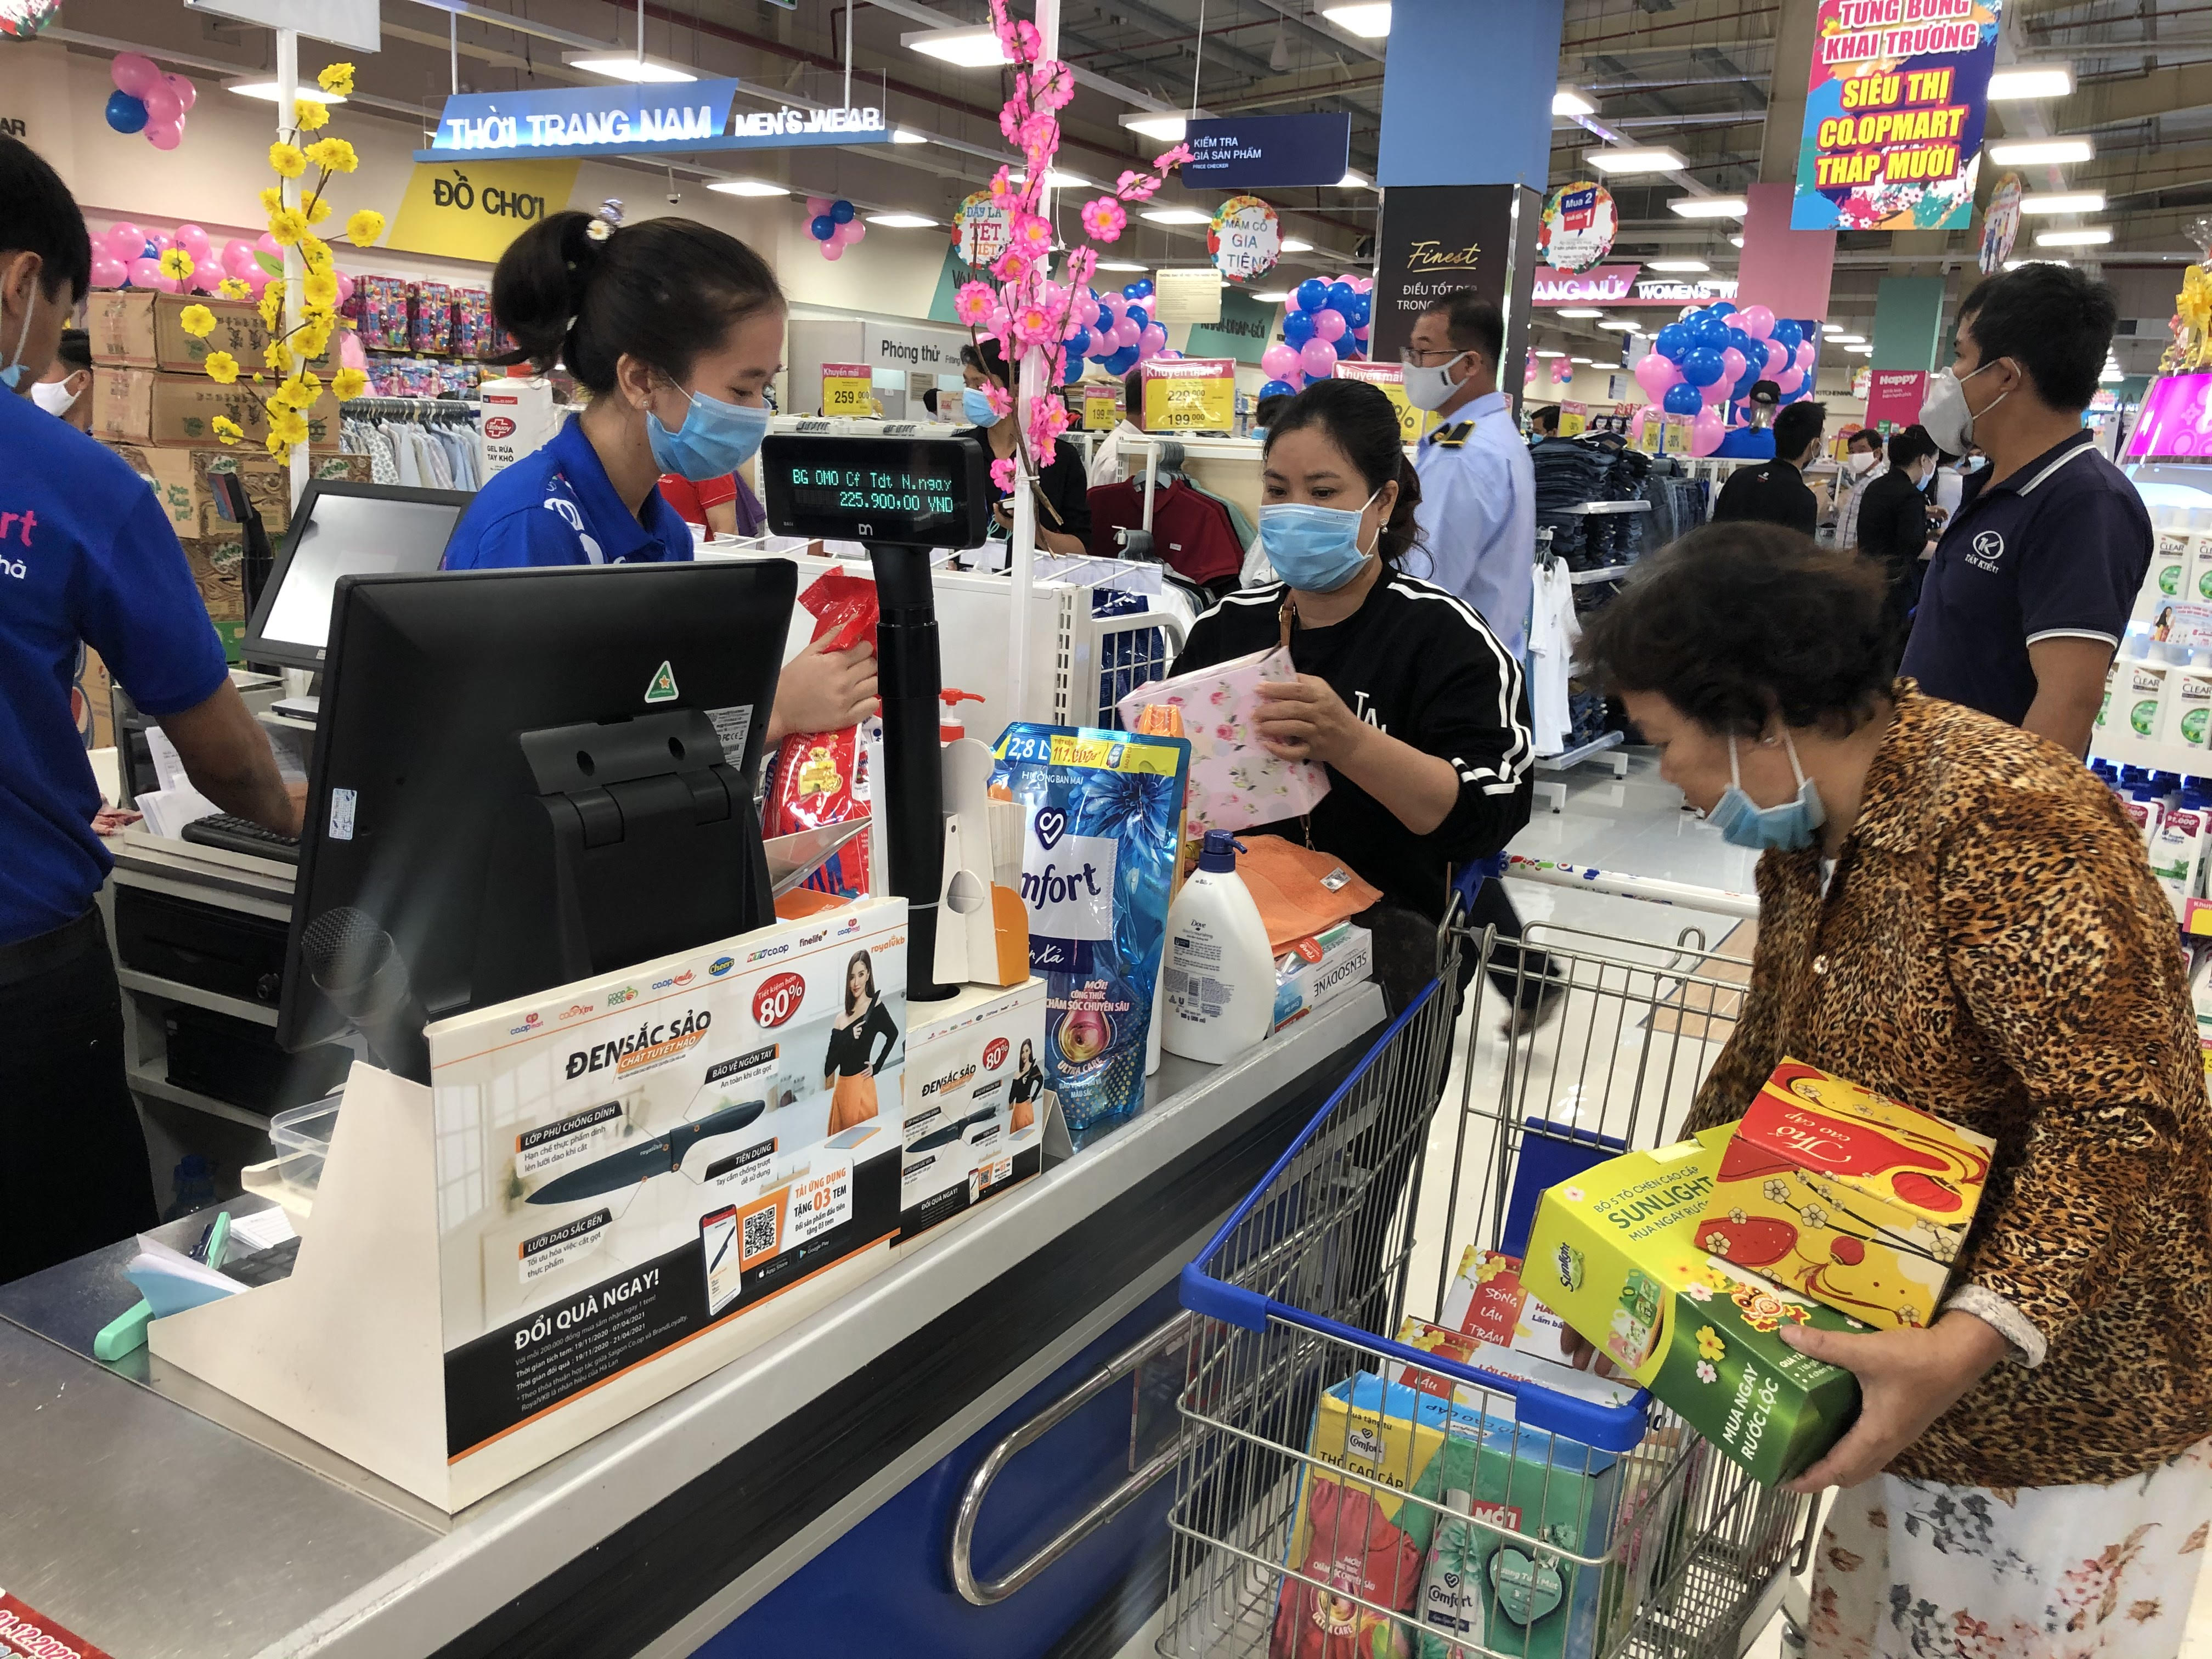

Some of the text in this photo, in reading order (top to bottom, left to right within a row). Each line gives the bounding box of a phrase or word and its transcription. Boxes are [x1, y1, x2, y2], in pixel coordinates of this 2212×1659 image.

[1825, 23, 1977, 61] KHAI TRƯƠNG
[1842, 70, 1950, 109] SIÊU THỊ
[447, 104, 879, 150] THỜI TRANG NAM MEN'S WEAR
[1819, 108, 1965, 149] CO.OPMART
[1193, 146, 1262, 161] GIÁ SẢN PHẨM
[1194, 136, 1238, 148] KIỂM TRA
[1817, 144, 1955, 185] THÁP MƯỜI
[433, 170, 545, 220] ĐỒ CHƠI
[1566, 193, 1592, 208] Mua 2
[1584, 209, 1592, 226] 1
[1232, 233, 1258, 249] GIA
[1407, 241, 1481, 268] Finest
[1403, 281, 1428, 295] ĐIỀU
[1431, 281, 1453, 295] TỐT
[882, 340, 919, 364] Phòng
[922, 344, 940, 363] thử
[823, 366, 859, 377] Khuyến mãi
[1880, 374, 1918, 386] Happy
[487, 424, 511, 432] Lifebuoy
[793, 469, 952, 492] BG OMO Cf Tdt N.ngay
[840, 492, 953, 513] 225.900,00 VND
[2159, 542, 2185, 552] CLEAR
[2133, 675, 2160, 687] CLEAR
[1056, 775, 1084, 785] BAN MAI
[1190, 919, 1206, 928] Dove
[799, 934, 823, 948] finelife
[709, 957, 735, 975] Cheers
[1313, 951, 1367, 997] SENSODYNE
[758, 975, 797, 1001] Tiết kiệm hơn
[1070, 990, 1105, 1000] CÔNG THỨC
[1084, 979, 1108, 990] MỚI!
[759, 982, 803, 1028] 80%
[1068, 1000, 1084, 1011] SÓC
[1084, 1001, 1114, 1012] CHUYÊN
[1115, 1001, 1130, 1012] SÂU
[670, 1009, 712, 1040] SẢO
[713, 1049, 773, 1077] BẢO VỆ NGÓN TAY
[986, 1045, 1008, 1070] 80%
[960, 1064, 976, 1079] SẢO
[525, 1105, 616, 1146] LỚP PHỦ CHỐNG DÍNH
[1784, 1113, 1850, 1141] cao cấp
[736, 1143, 771, 1165] TIỆN DỤNG
[795, 1167, 846, 1199] TẢI ỨNG DỤNG
[1593, 1200, 1611, 1213] BỘ
[1616, 1189, 1634, 1200] TÔ
[1633, 1180, 1662, 1194] CHÉN
[1660, 1172, 1682, 1184] CAO
[1680, 1166, 1699, 1177] CẤP
[794, 1184, 847, 1218] TẶNG 03 TEM
[1608, 1176, 1714, 1229] SUNLIGHT
[528, 1214, 603, 1252] LƯỠI DAO SẮC BÉN
[1628, 1210, 1686, 1242] MUA NGAY
[1559, 1242, 1574, 1293] Sunlight
[515, 1268, 659, 1351] ĐỔI QUÀ NGAY!
[516, 1311, 645, 1379] Thời gian tích tem: 19/11/2020 07/04/2021
[1723, 1362, 1758, 1444] MUA NGAY
[1741, 1378, 1779, 1461] RƯỚC LỘC
